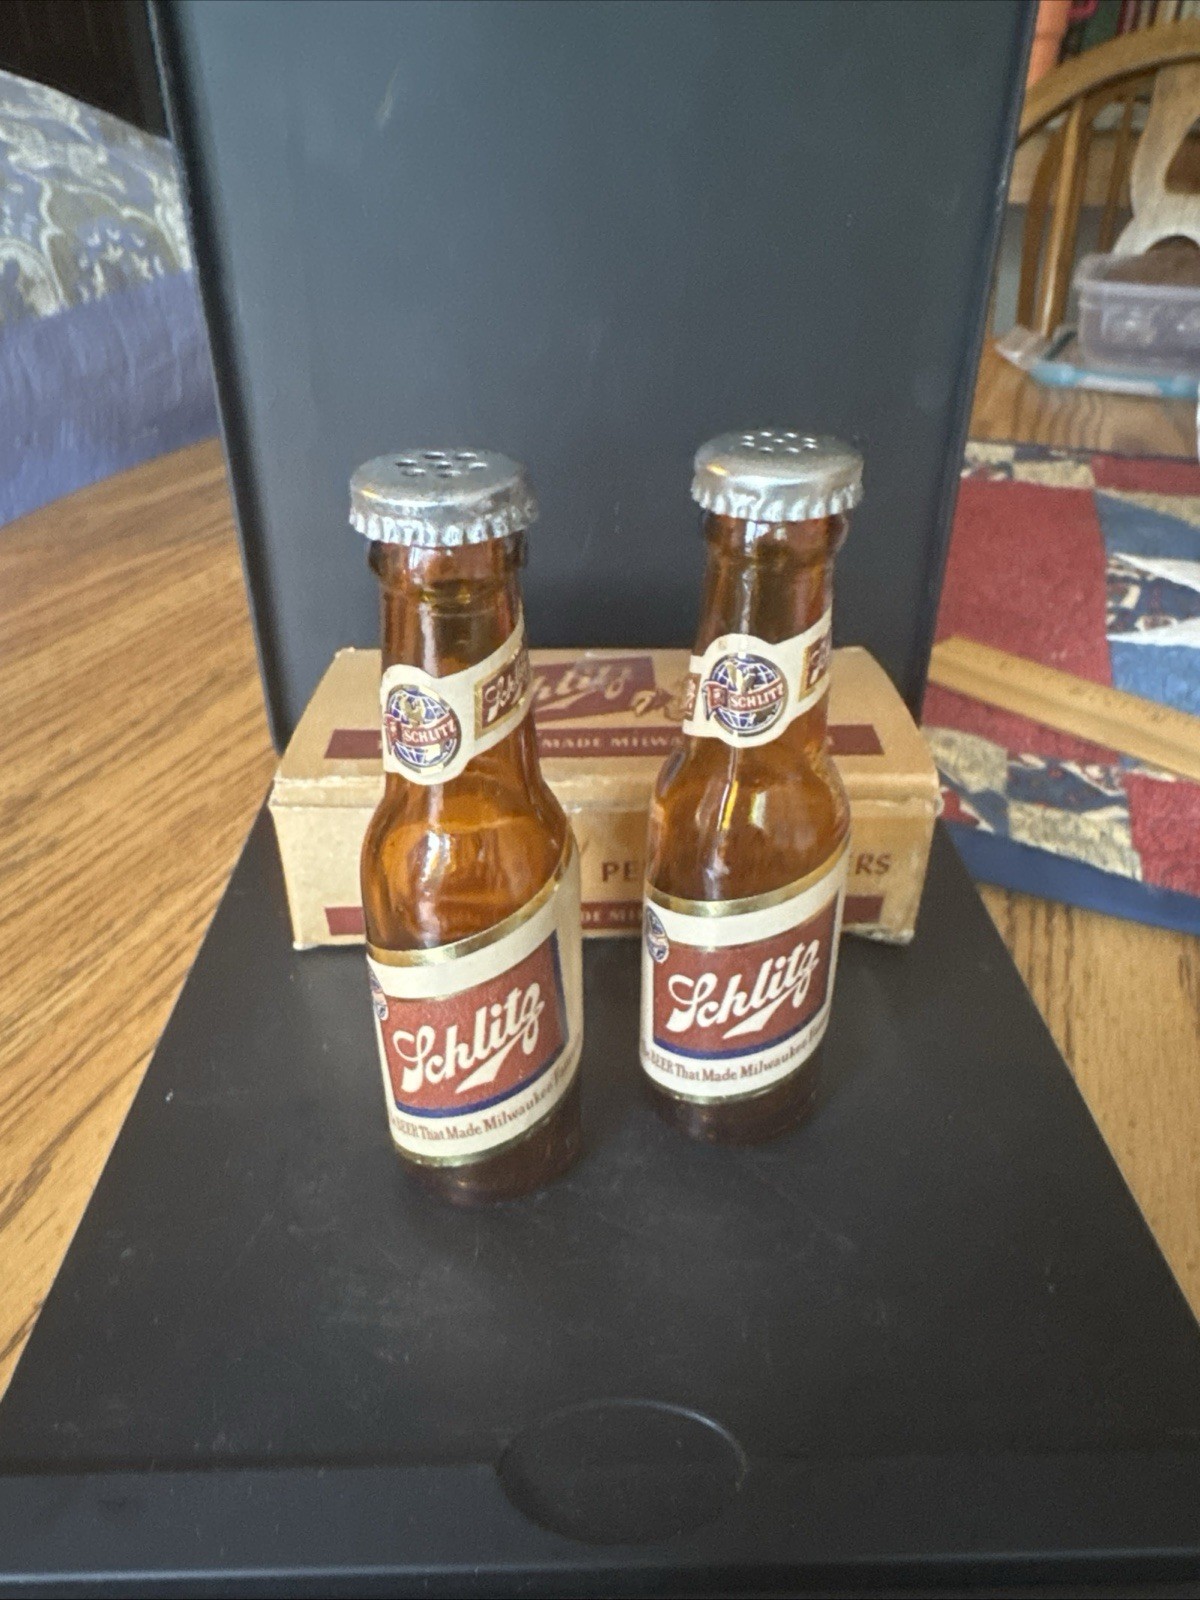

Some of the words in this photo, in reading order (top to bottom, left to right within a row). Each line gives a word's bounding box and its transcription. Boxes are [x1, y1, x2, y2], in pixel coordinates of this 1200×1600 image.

[730, 681, 785, 708] SCHLITZ
[402, 718, 457, 744] SCHLITZ
[541, 737, 601, 749] MADE
[665, 939, 820, 1039] Schlitz
[393, 982, 545, 1094] Schlitz
[675, 1063, 700, 1081] That
[702, 1067, 738, 1082] Made
[740, 1039, 808, 1079] Milwaukee
[418, 1125, 445, 1141] That
[445, 1122, 482, 1140] Made
[483, 1081, 554, 1133] Milwaukee
